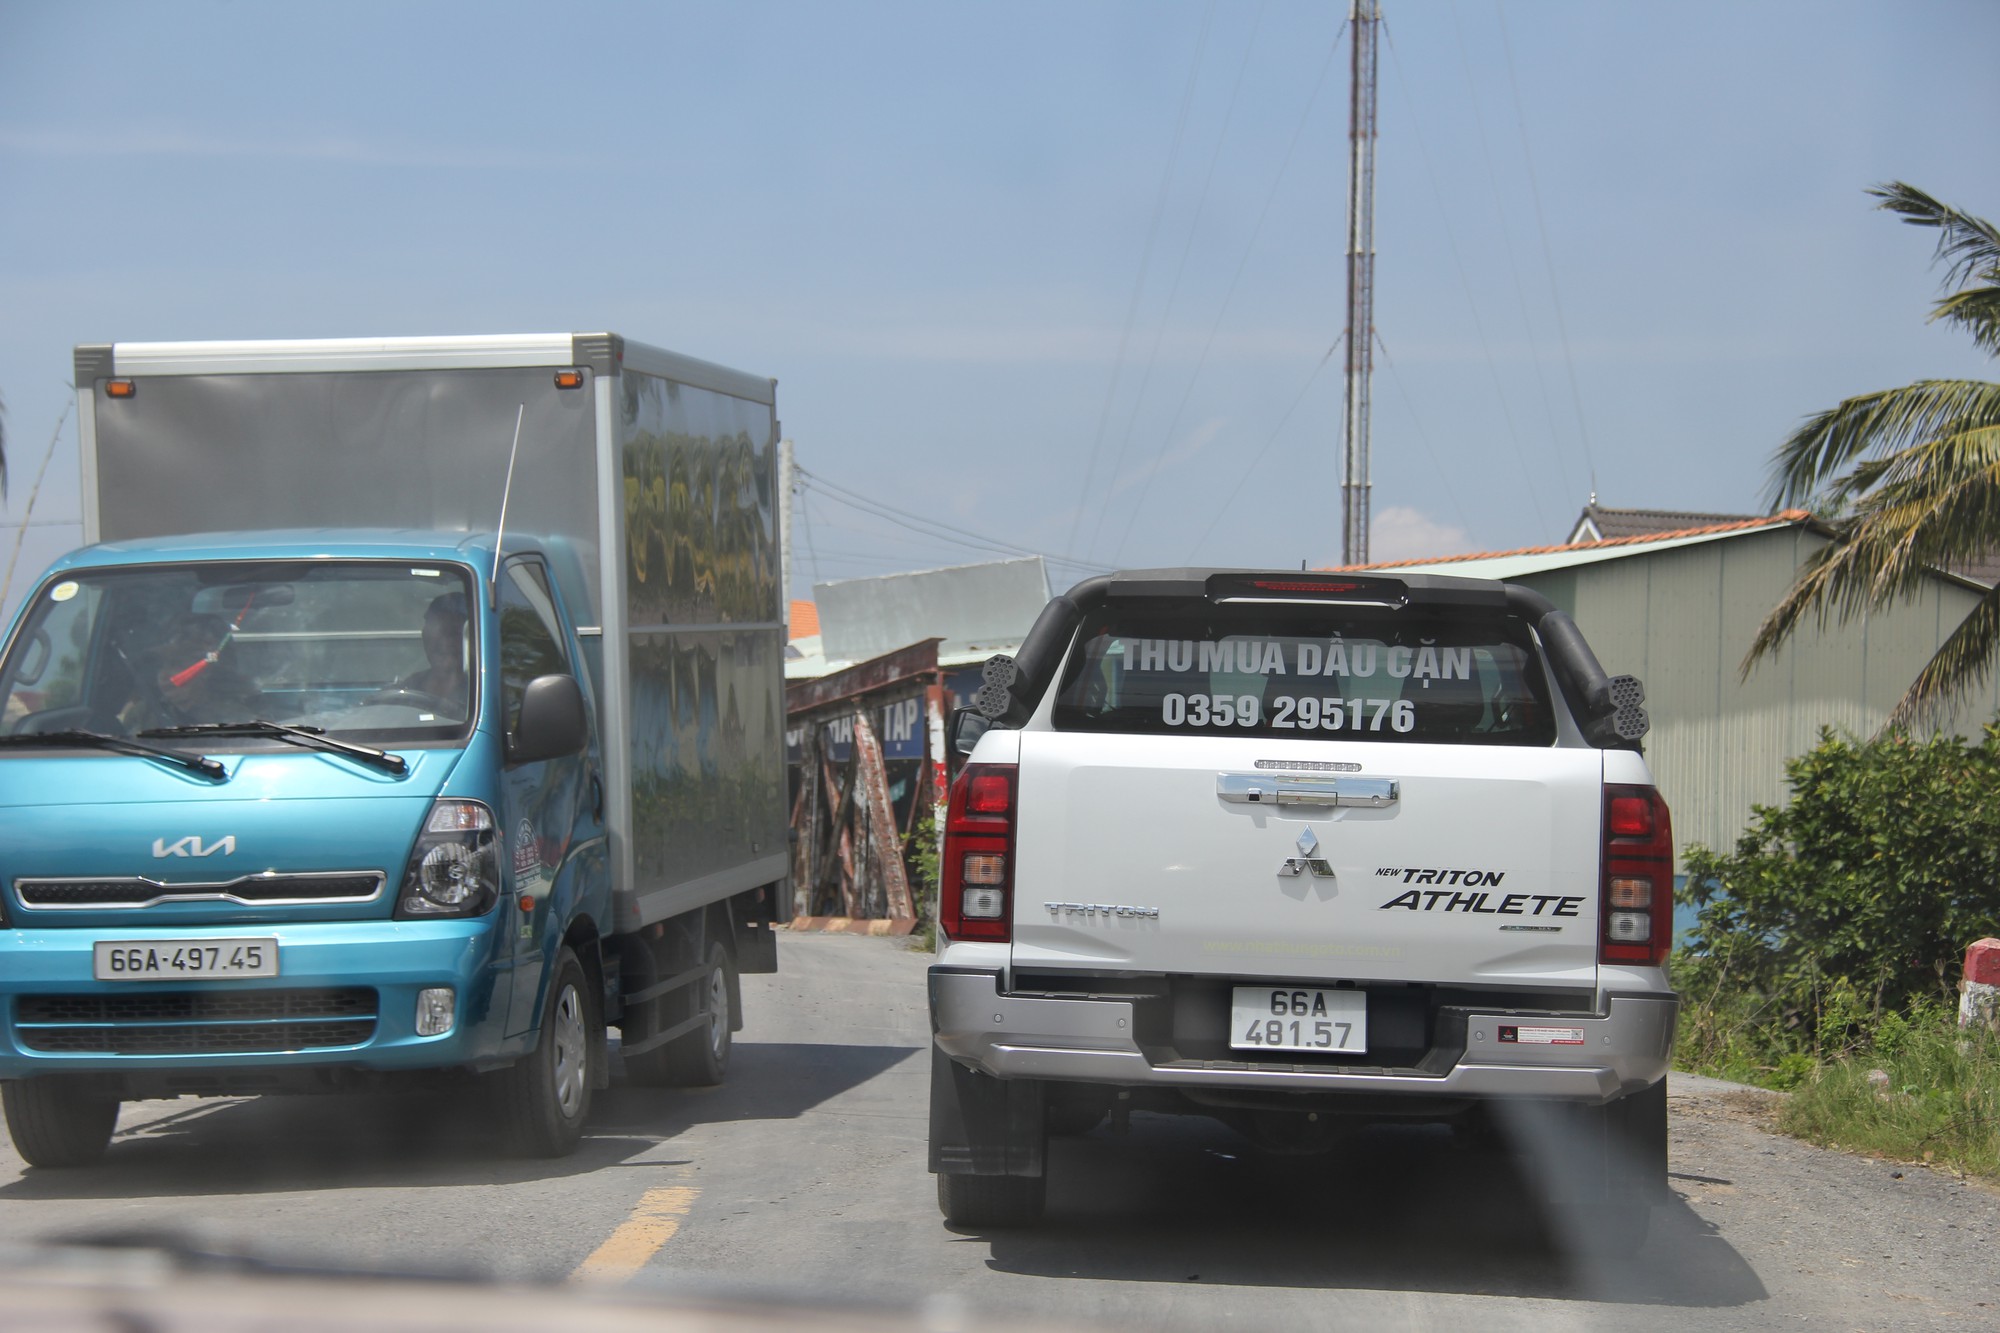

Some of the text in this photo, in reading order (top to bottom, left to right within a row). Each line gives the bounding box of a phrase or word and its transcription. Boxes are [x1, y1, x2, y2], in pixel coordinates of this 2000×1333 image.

[1119, 631, 1471, 689] THU MUA DẦU CẶN
[1162, 693, 1415, 733] 0359 295176
[152, 835, 236, 858] KIA
[1375, 867, 1506, 887] NEW TRITON
[1379, 889, 1587, 917] ATHLETE
[111, 946, 262, 972] 66A-497.45
[1270, 990, 1328, 1018] 66A
[1245, 1019, 1352, 1049] 481.57
